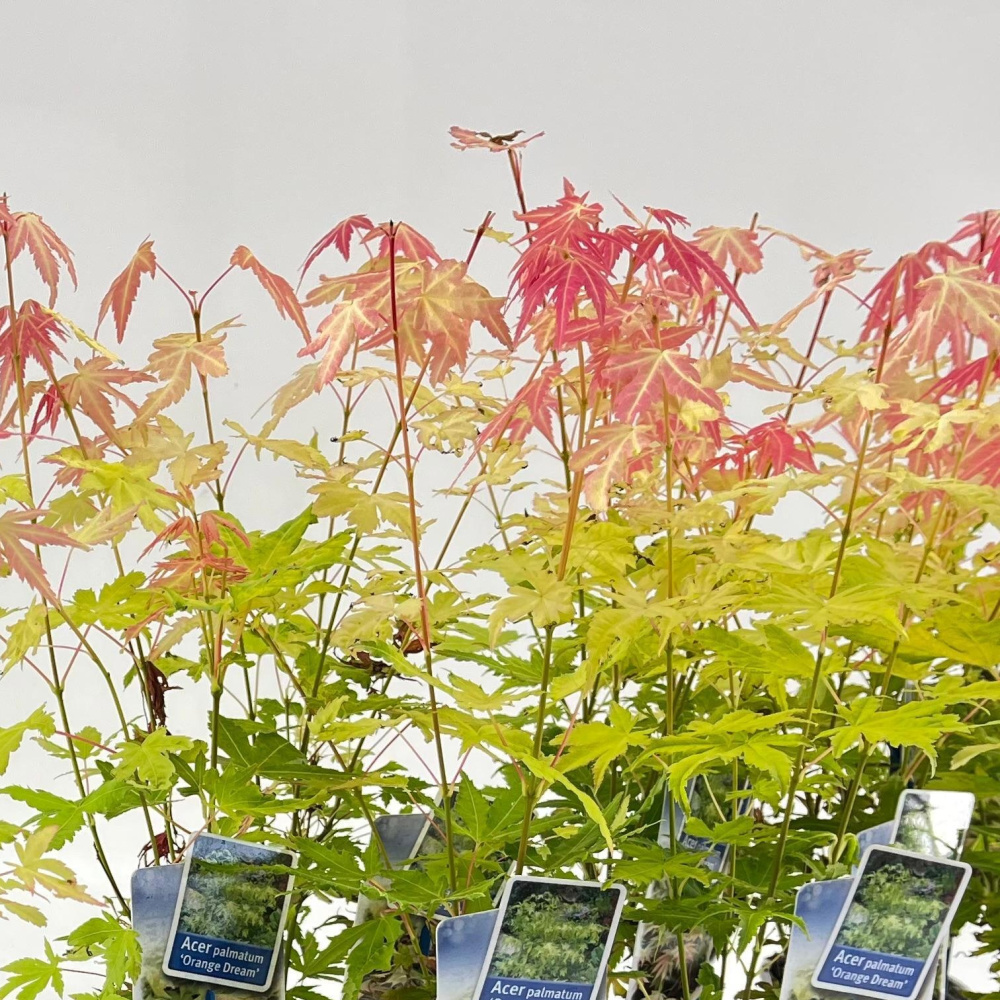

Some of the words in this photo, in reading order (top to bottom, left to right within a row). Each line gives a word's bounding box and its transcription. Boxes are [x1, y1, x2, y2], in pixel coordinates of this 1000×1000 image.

[181, 936, 212, 954] Acer
[212, 947, 264, 964] palmatum
[833, 949, 866, 967] Acer
[863, 959, 915, 976] palmatum
[490, 980, 526, 996] Acer
[525, 987, 583, 1000] palmatum
